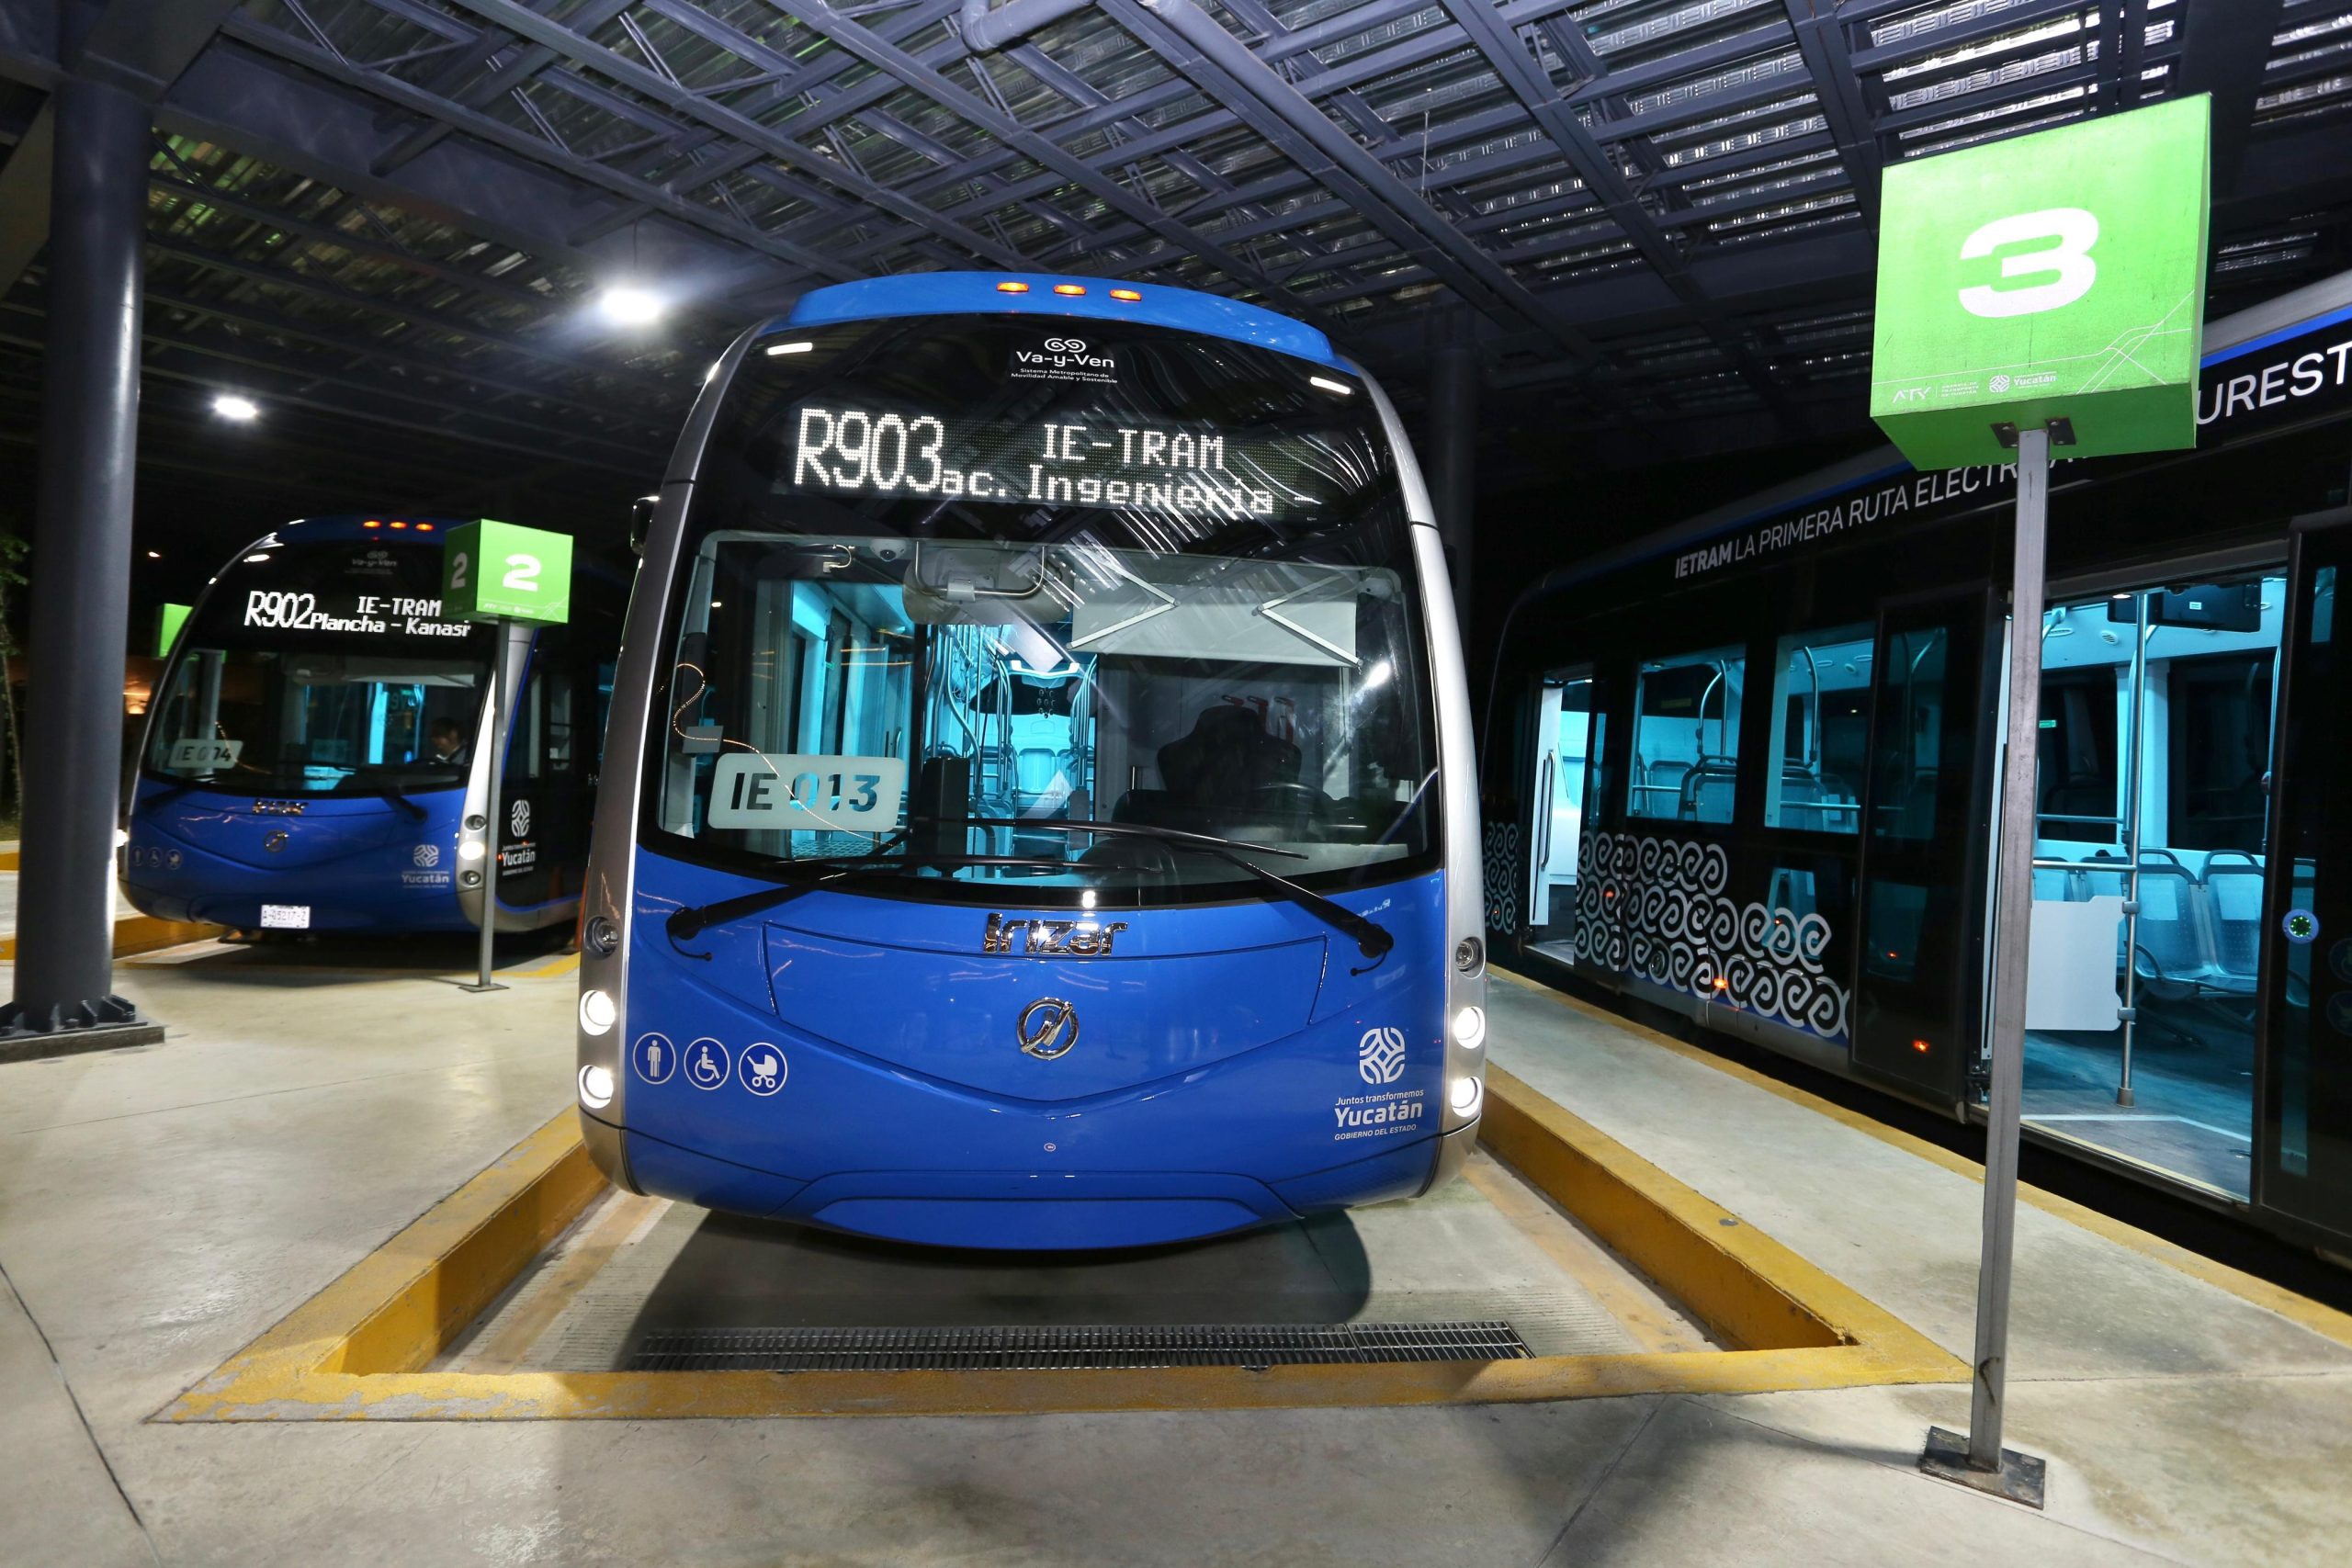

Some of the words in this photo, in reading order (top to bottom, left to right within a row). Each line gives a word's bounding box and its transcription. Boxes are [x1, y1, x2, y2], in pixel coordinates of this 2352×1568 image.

[1957, 207, 2099, 318] 3
[1016, 351, 1114, 367] Va-y-Ven
[1049, 369, 1099, 378] Metropolitano
[2013, 374, 2057, 386] Yucatán
[795, 408, 944, 491] R903
[1043, 423, 1223, 469] IE-TRAM
[942, 469, 1006, 497] ac.
[1675, 541, 1733, 579] IETRAM
[1735, 534, 1756, 560] LA
[1758, 506, 1843, 555] PRIMERA
[1849, 485, 1908, 527] RUTA
[450, 552, 468, 590] 2
[503, 553, 542, 592] 2
[243, 590, 315, 629] R902
[356, 595, 443, 617] IE-TRAM
[309, 612, 386, 633] Plancha
[730, 773, 778, 811] IE
[789, 771, 881, 813] 013
[502, 848, 536, 867] Yucatán
[401, 874, 449, 883] Yucatán
[1335, 1097, 1364, 1106] Juntos
[1365, 1089, 1424, 1102] transformemos
[1334, 1100, 1423, 1128] Yucatán
[1334, 1130, 1374, 1141] GOBIERNO
[1389, 1123, 1417, 1134] ESTADO
